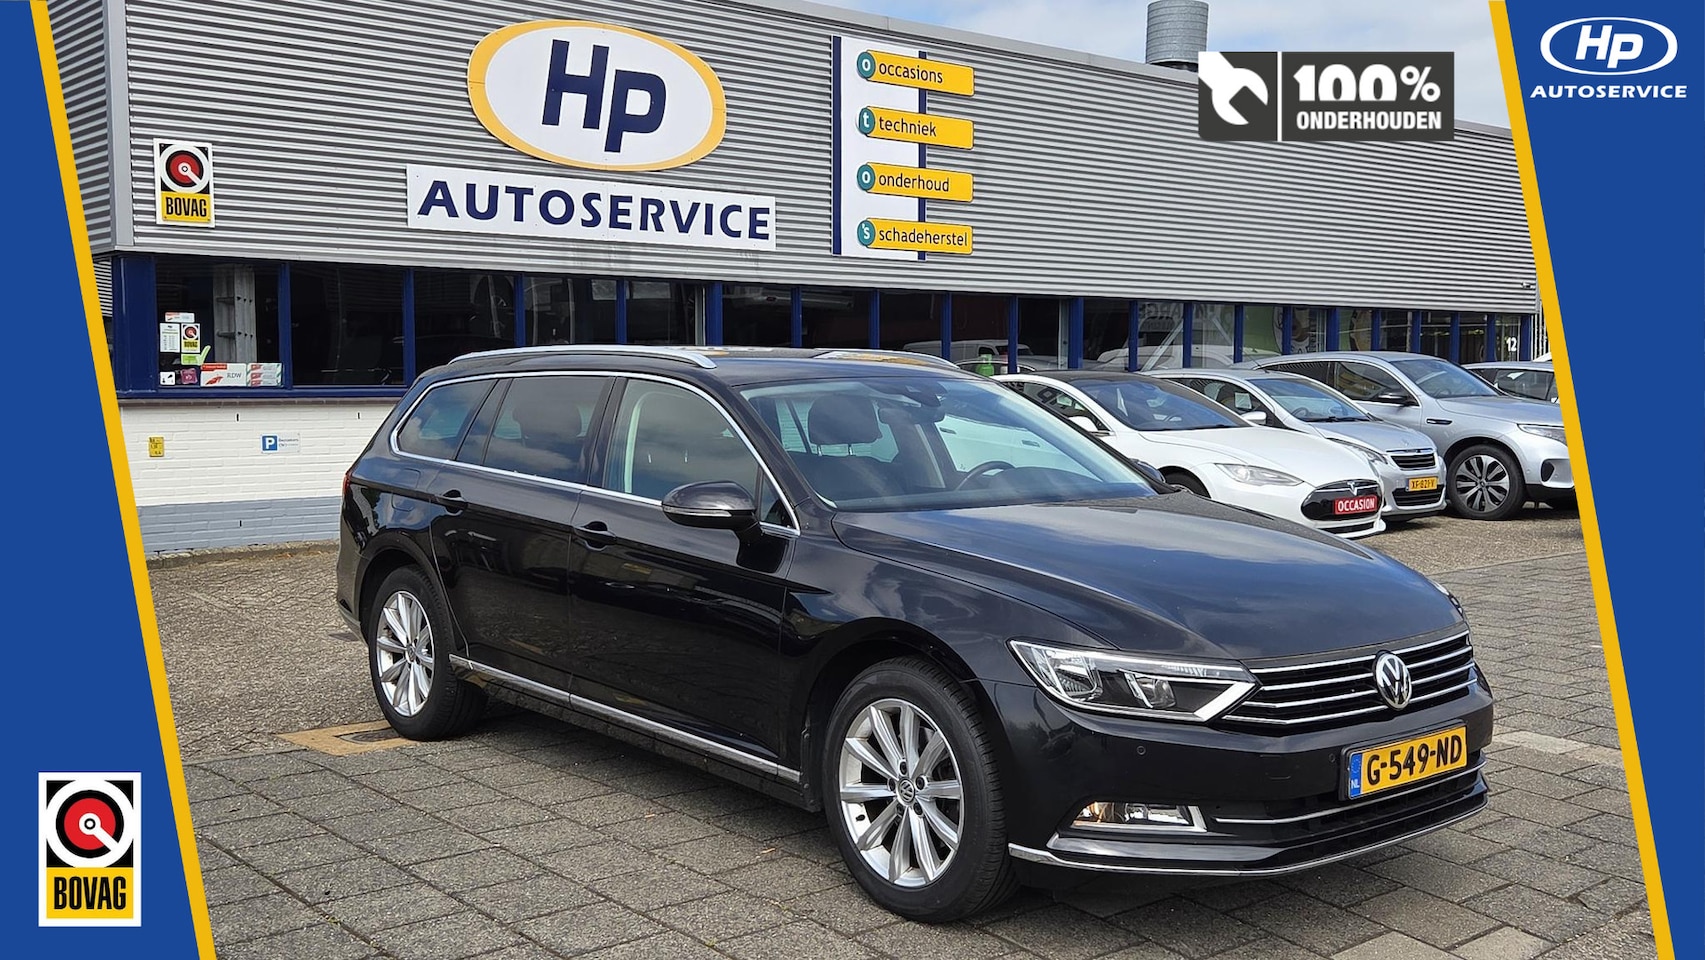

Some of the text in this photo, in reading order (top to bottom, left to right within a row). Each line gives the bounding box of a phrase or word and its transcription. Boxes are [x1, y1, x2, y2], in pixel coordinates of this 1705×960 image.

[879, 63, 943, 84] occasions
[879, 116, 937, 137] techniek
[878, 173, 950, 192] onderhoud
[165, 196, 207, 217] BOVAG
[417, 180, 770, 240] AUTOSERVICE
[879, 228, 968, 246] schadeherstel
[1506, 336, 1517, 352] 12
[1337, 497, 1375, 512] OCCASION
[1350, 735, 1462, 789] NL G-549-ND
